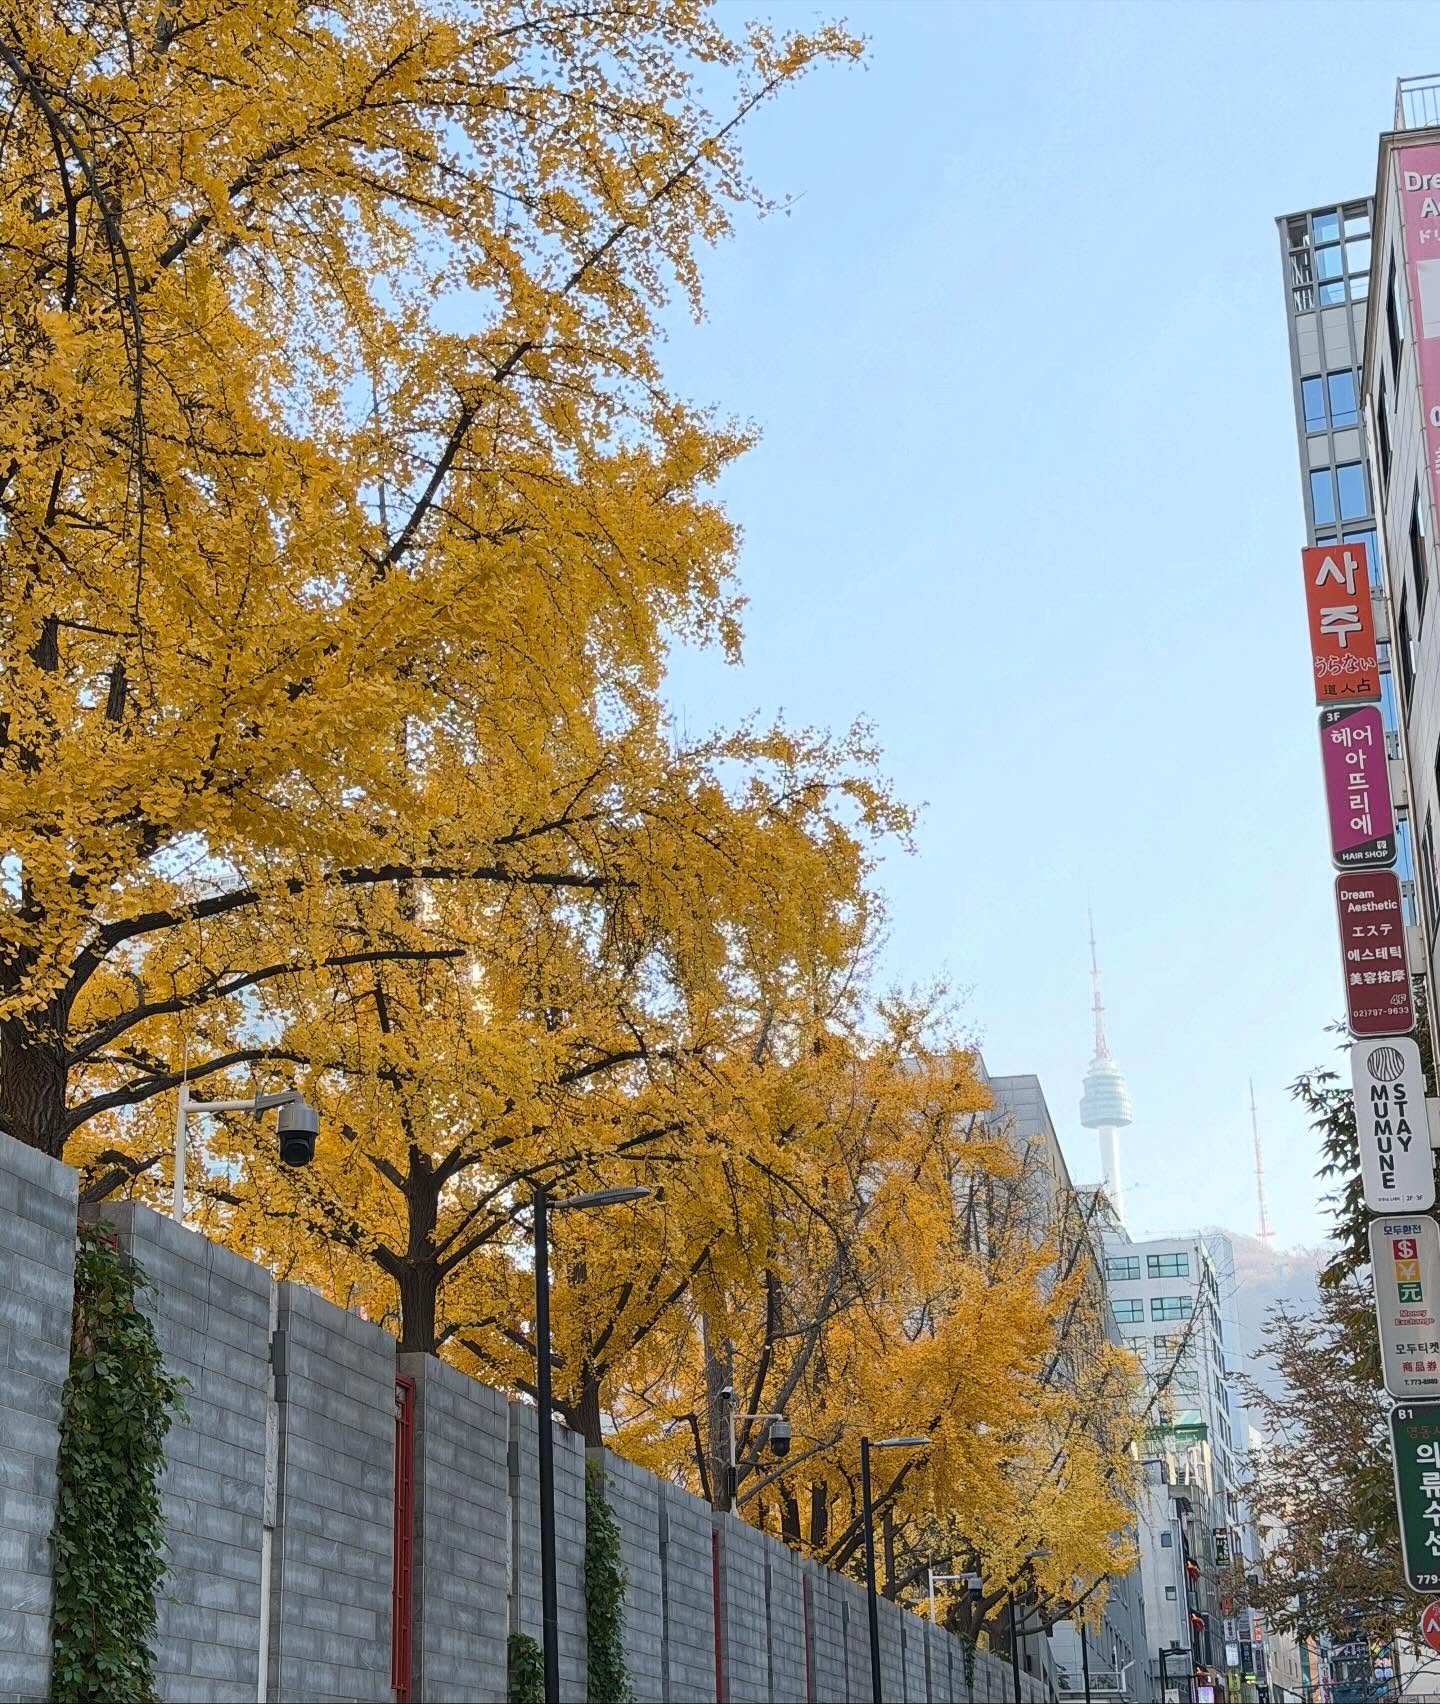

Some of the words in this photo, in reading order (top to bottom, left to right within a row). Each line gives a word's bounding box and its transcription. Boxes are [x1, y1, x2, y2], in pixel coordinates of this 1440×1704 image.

[1315, 551, 1362, 648] 사주
[1315, 653, 1377, 678] うらない
[1326, 712, 1341, 722] 3F
[1342, 852, 1363, 861] HAIR
[1364, 850, 1388, 859] SHOP
[1340, 890, 1375, 901] Dream
[1347, 899, 1398, 913] Aesthetic
[1352, 923, 1393, 937] エステ
[1347, 945, 1403, 962] 에스테틱
[1350, 969, 1406, 986] 美容按摩
[1390, 993, 1407, 1005] 4F
[1393, 1083, 1412, 1153] STAY
[1370, 1084, 1396, 1190] MUMUNE
[1384, 1224, 1422, 1236] 모두환전
[1401, 1283, 1421, 1301] 元
[1398, 1409, 1414, 1420] B1
